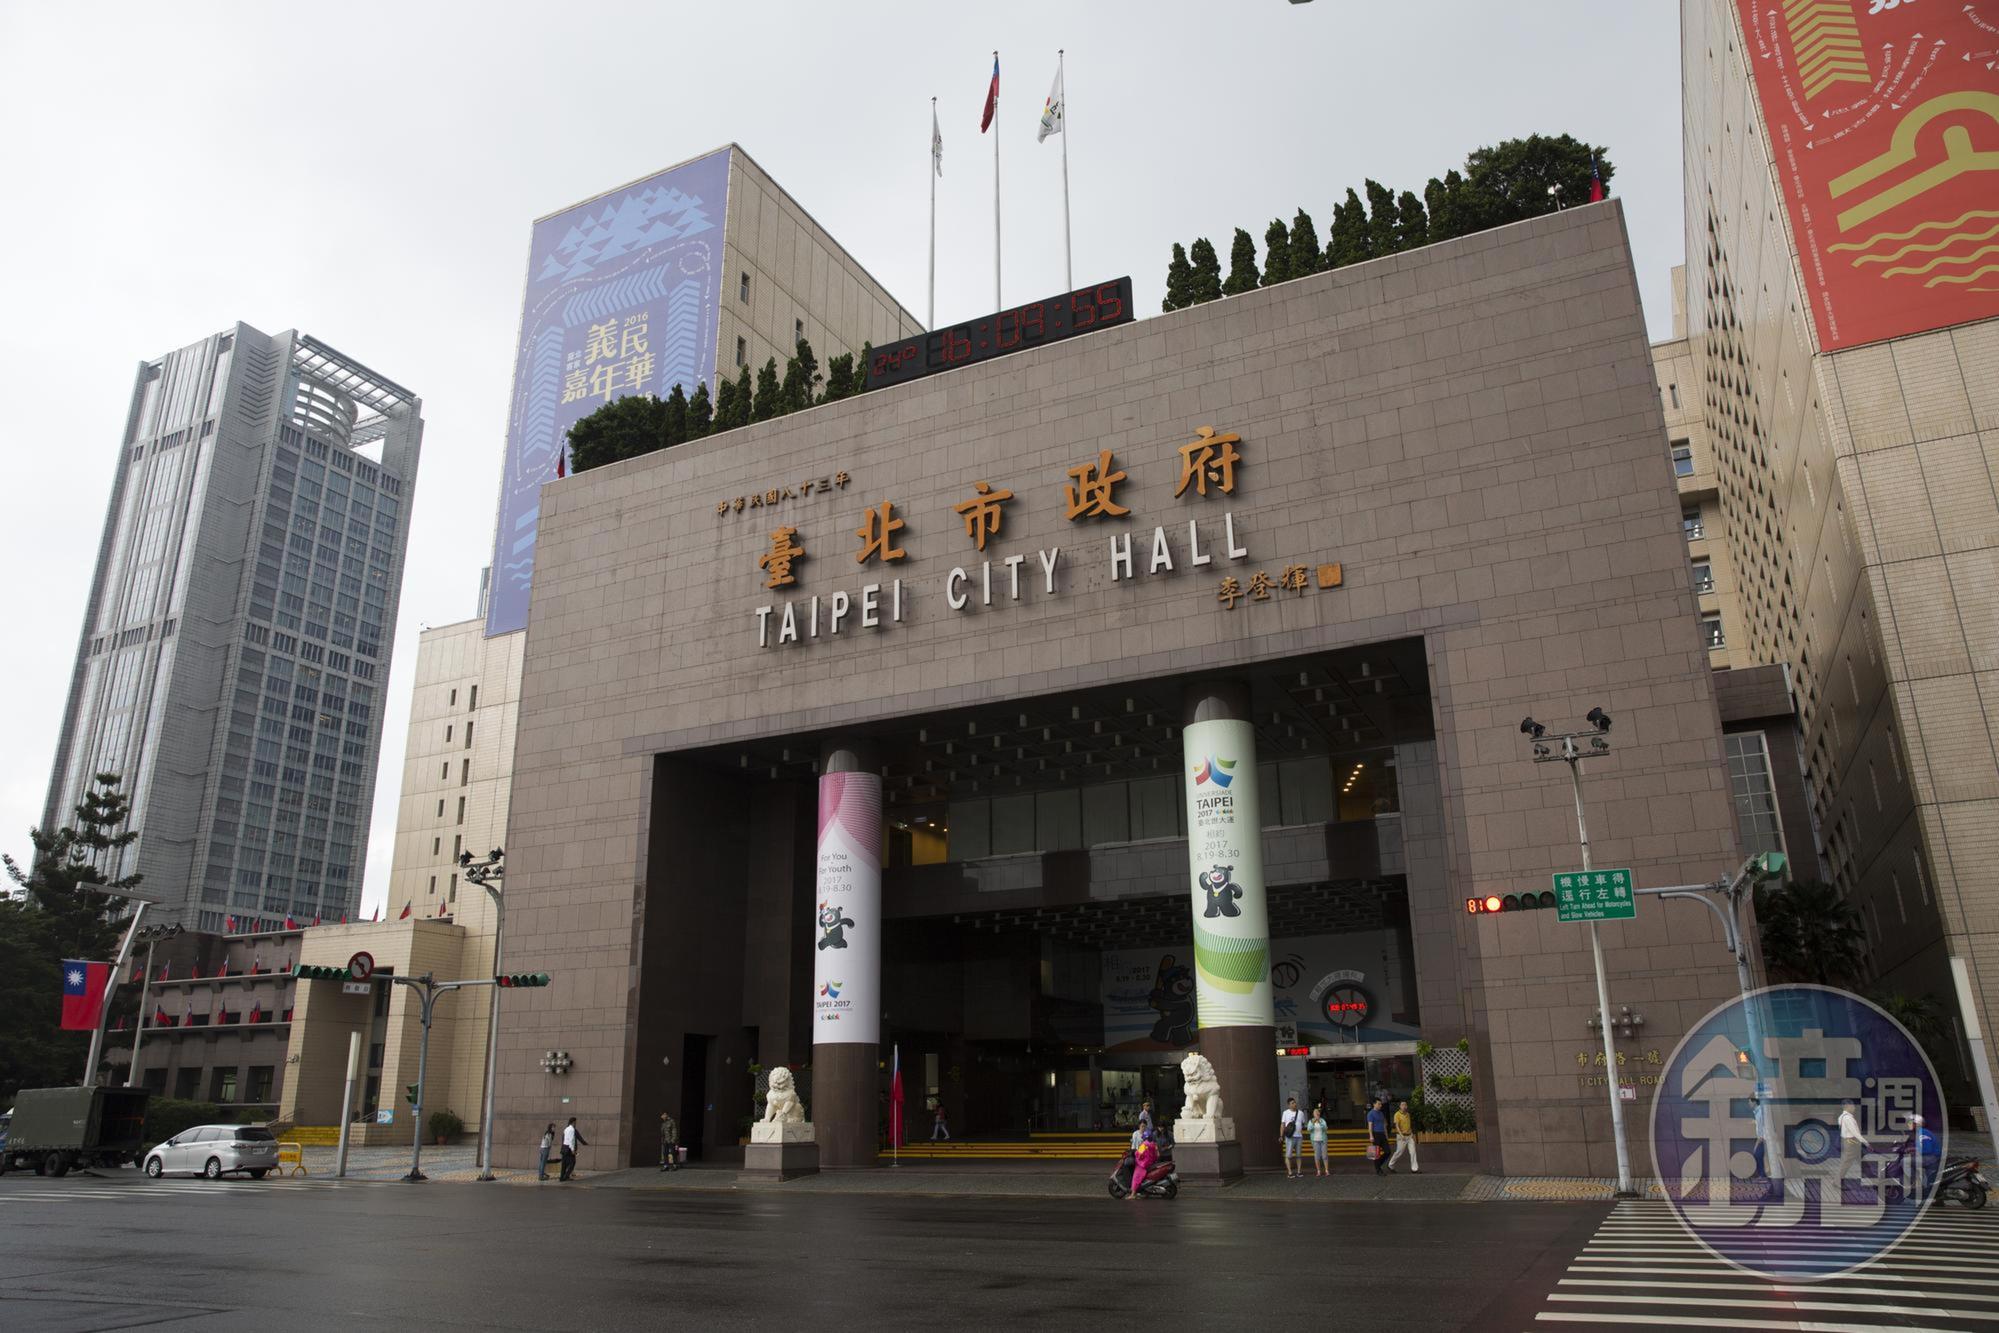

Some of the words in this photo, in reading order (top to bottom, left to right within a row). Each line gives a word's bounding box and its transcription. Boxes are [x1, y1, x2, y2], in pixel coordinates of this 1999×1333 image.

[624, 311, 648, 327] 2016
[942, 280, 1122, 363] 16:09:55
[584, 318, 649, 365] 義民
[561, 352, 656, 405] 嘉年華
[716, 471, 851, 517] 中華民國八十三年
[758, 426, 1242, 590] 臺北市政府
[755, 579, 903, 648] TAIPEI
[946, 546, 1060, 611] CITY
[1110, 512, 1249, 582] HALL
[1218, 563, 1310, 611] 李登輝
[1196, 796, 1233, 810] TAIPEI
[1197, 809, 1213, 818] 2017
[1204, 840, 1228, 851] 2017
[831, 852, 848, 860] You
[828, 864, 852, 873] Youth
[1559, 872, 1625, 888] 機慢車得
[1468, 899, 1484, 913] 81
[1559, 903, 1569, 911] Left
[1605, 900, 1632, 909] Motorcycles
[833, 1000, 851, 1008] 2017
[1587, 1077, 1609, 1087] CITY
[1615, 1076, 1636, 1086] ALL
[1640, 1075, 1666, 1086] ROAD
